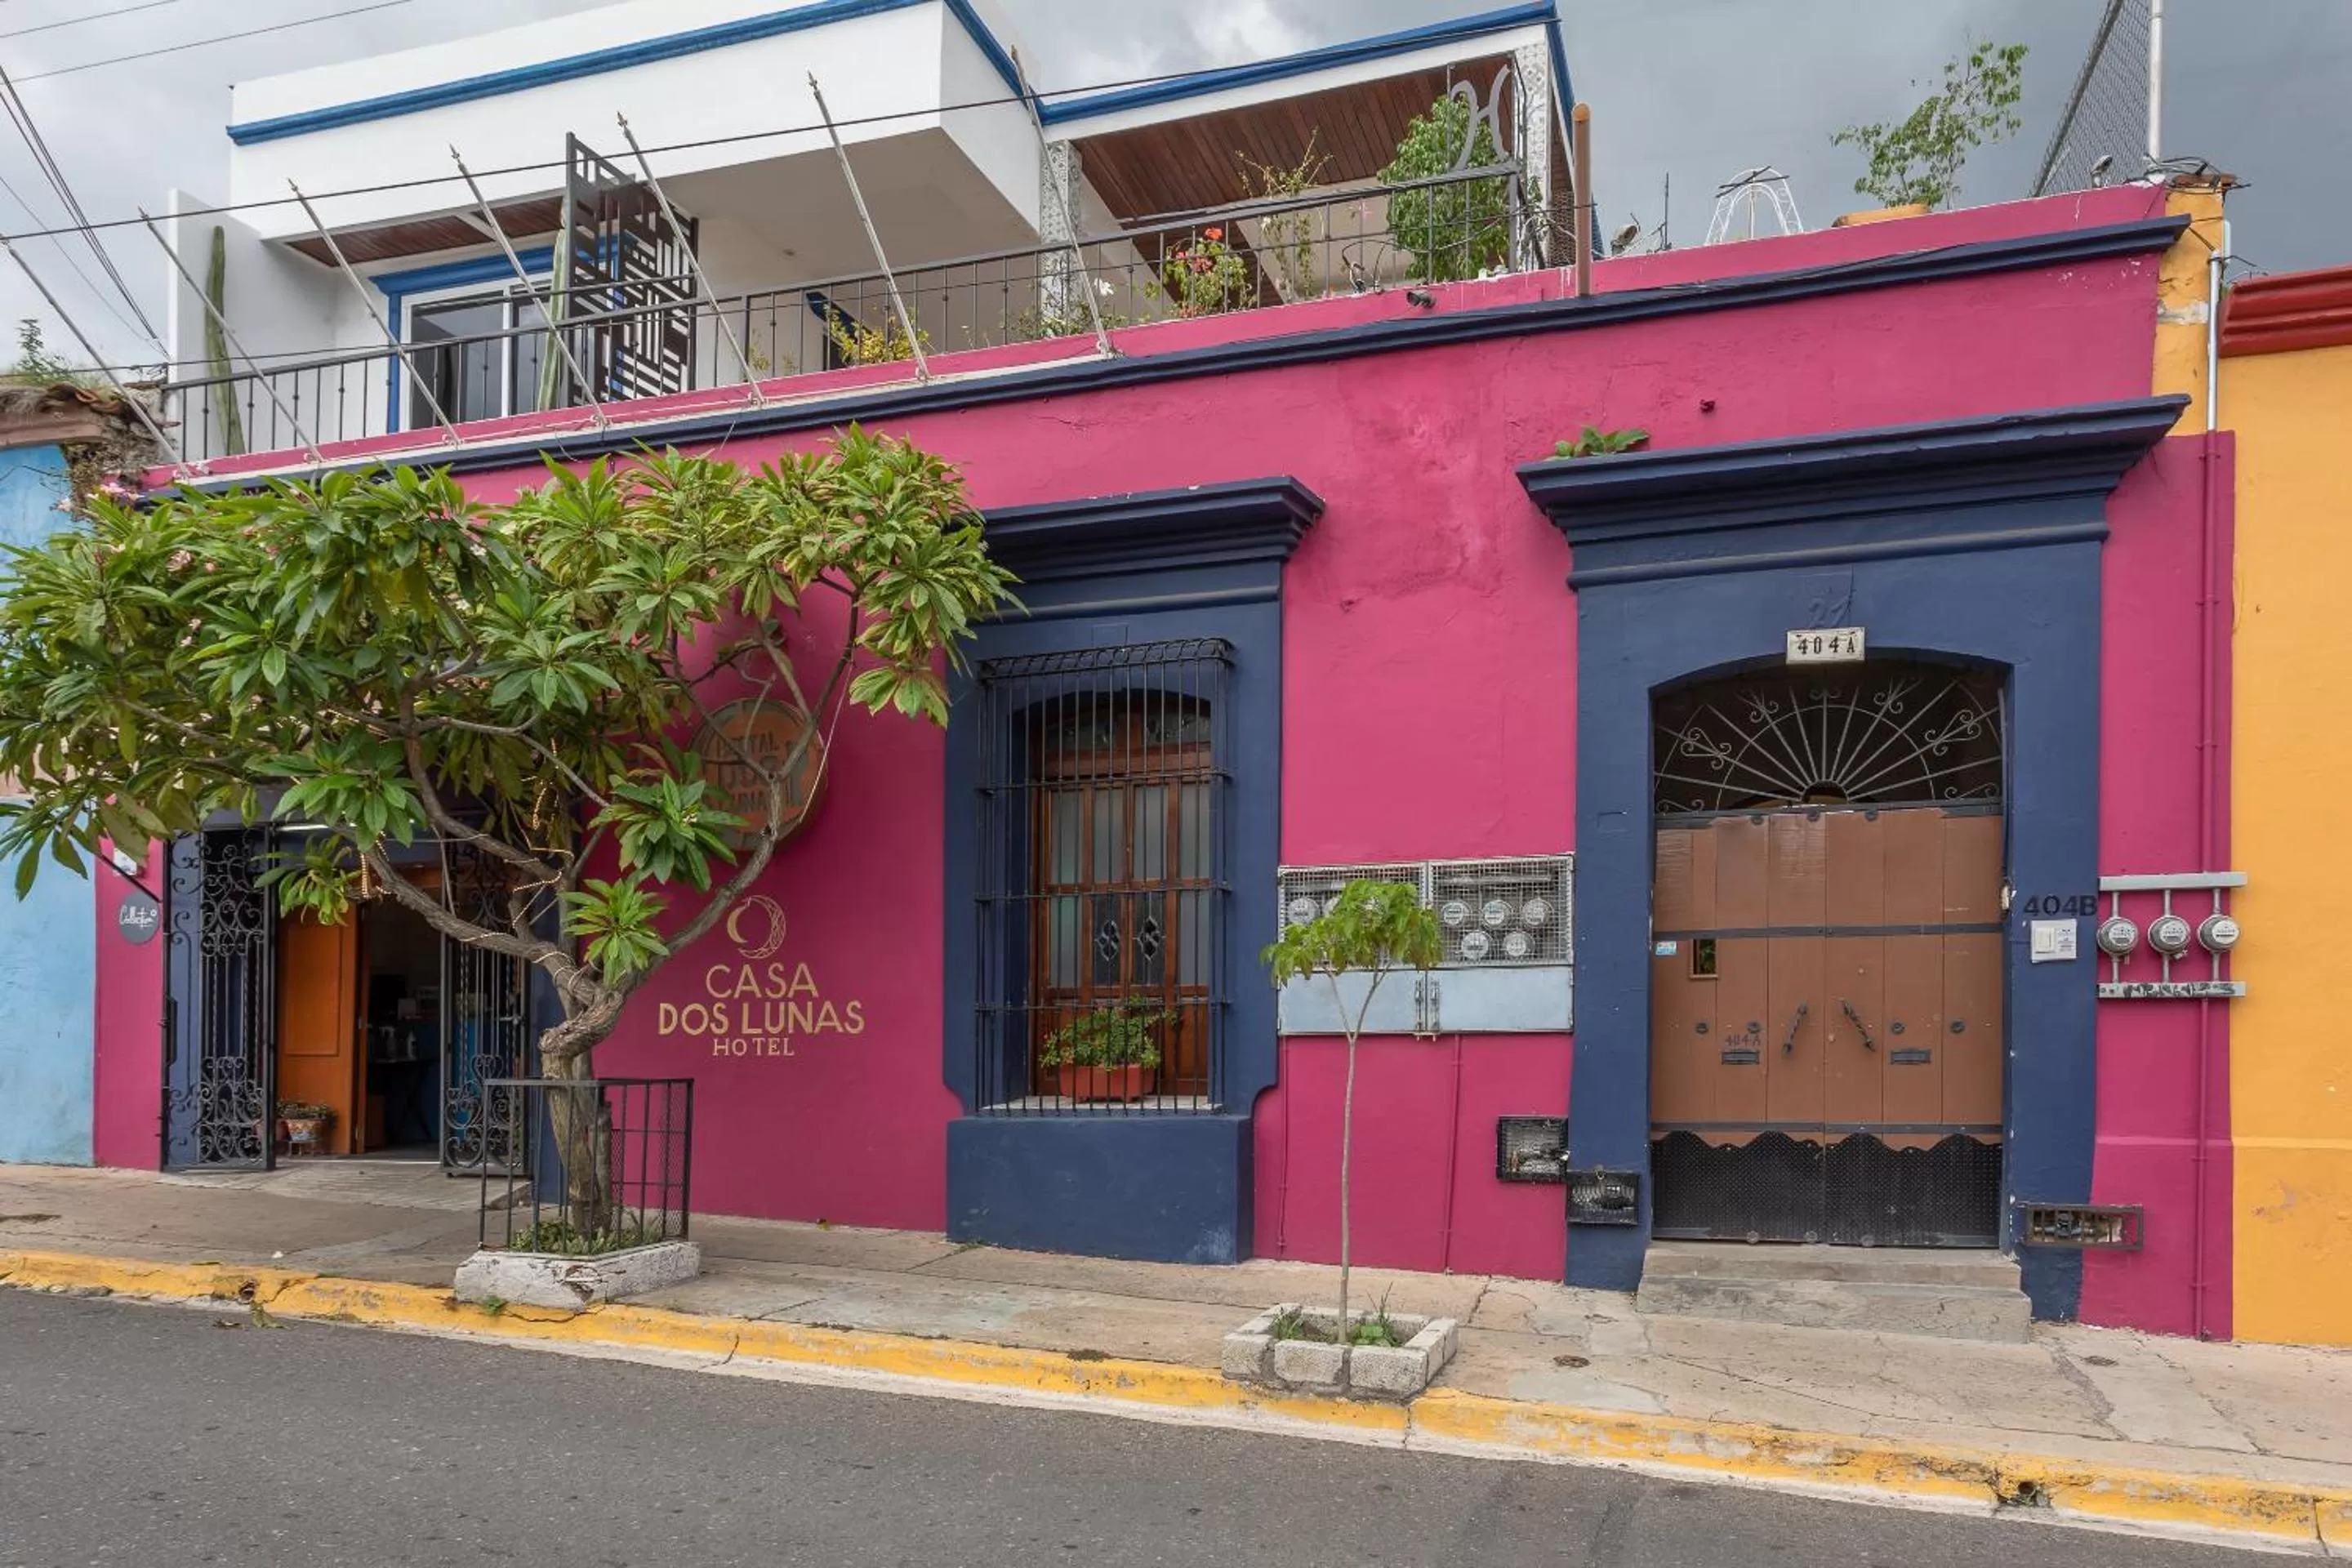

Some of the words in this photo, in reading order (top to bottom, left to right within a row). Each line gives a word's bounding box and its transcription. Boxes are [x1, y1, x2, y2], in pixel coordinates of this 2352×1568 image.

[1797, 635, 1855, 654] 404A
[2024, 894, 2098, 916] 404B
[706, 962, 819, 999] CASA
[658, 1002, 729, 1036] DOS
[741, 1000, 866, 1035] LUNAS
[712, 1037, 795, 1057] HOTEL
